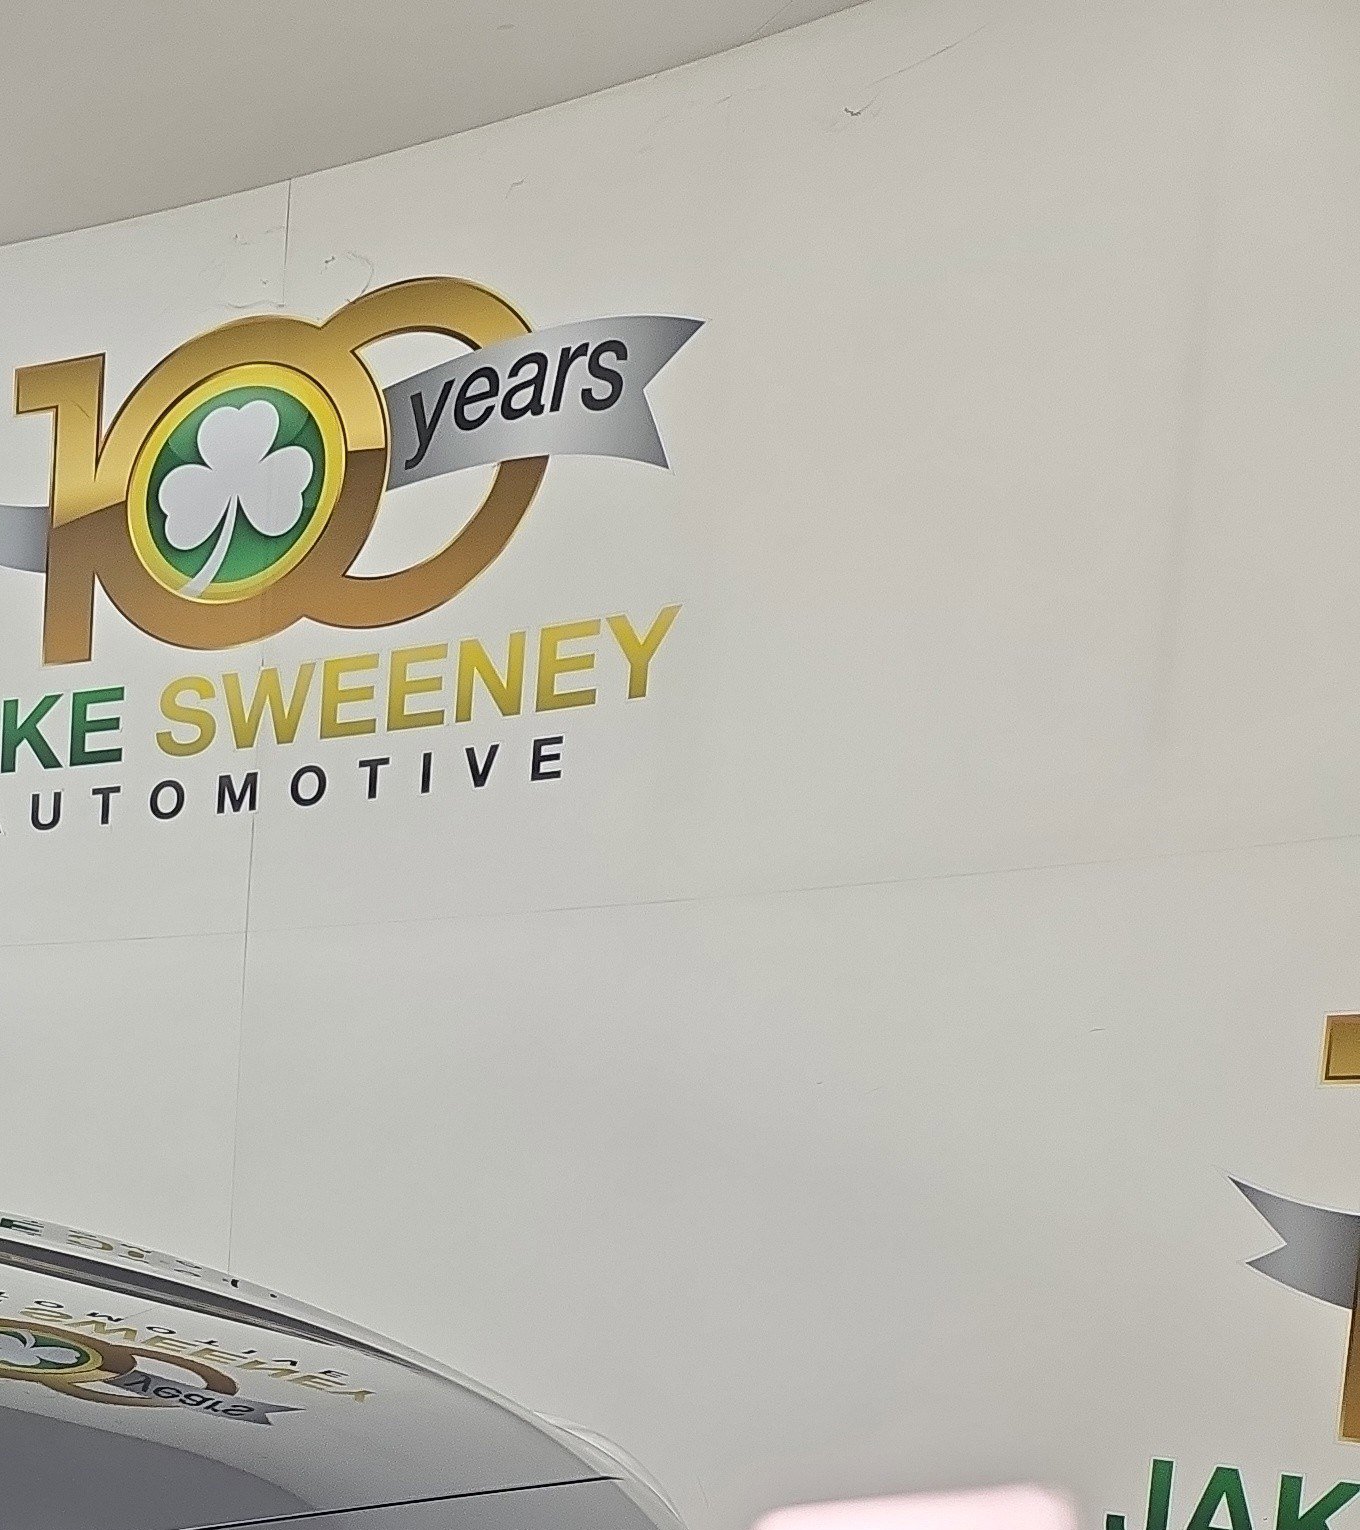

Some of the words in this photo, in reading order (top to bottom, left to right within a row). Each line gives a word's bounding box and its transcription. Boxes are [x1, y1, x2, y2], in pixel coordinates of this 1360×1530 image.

[13, 277, 550, 667] 100
[405, 338, 630, 471] years
[156, 605, 682, 759] SWEENEY
